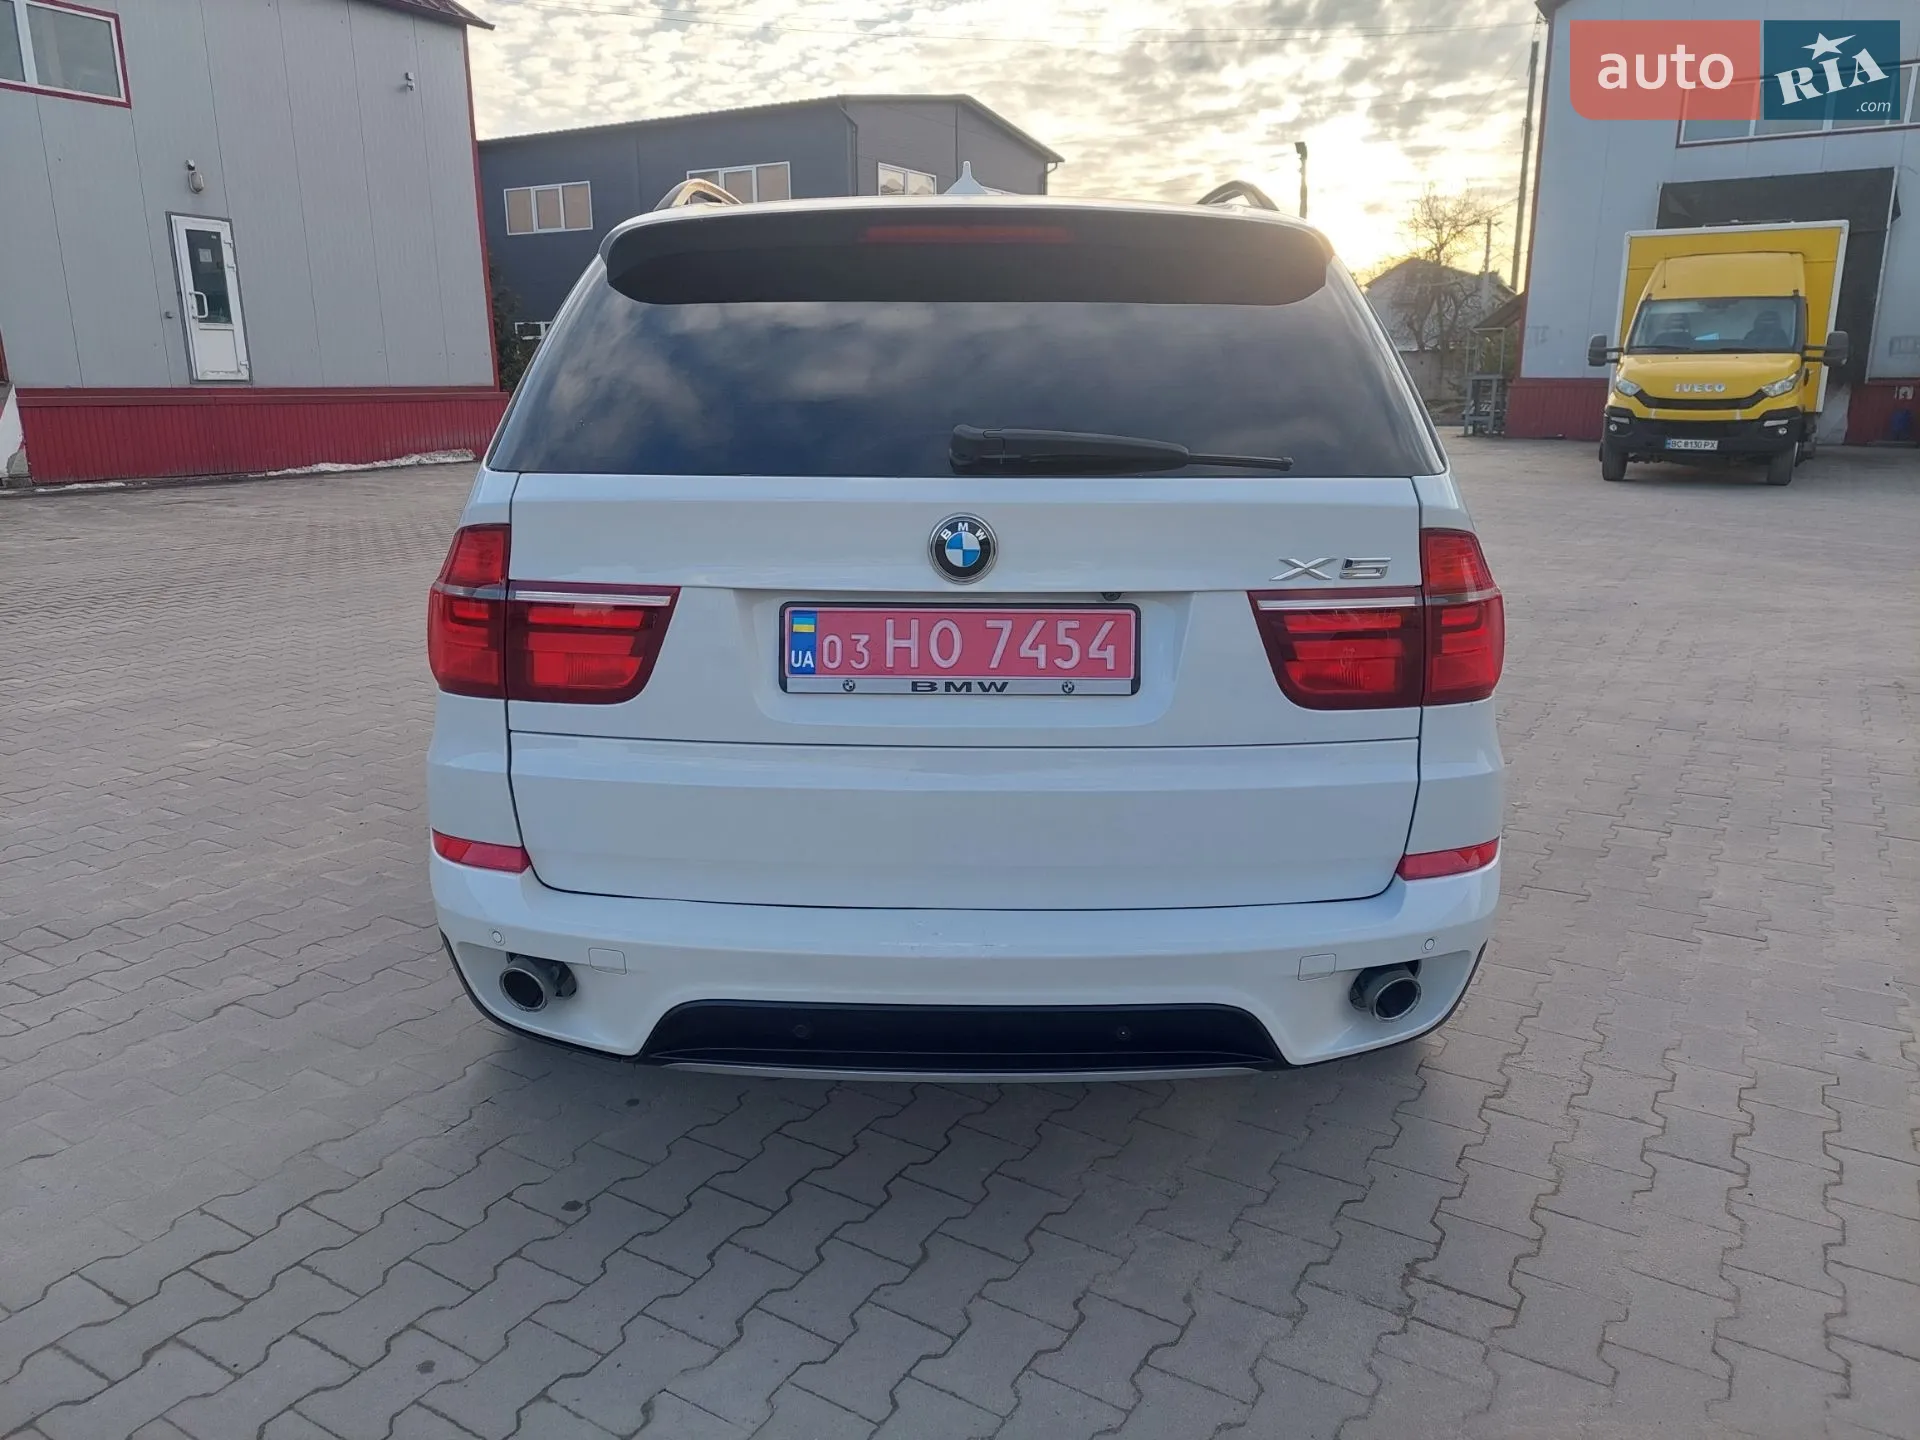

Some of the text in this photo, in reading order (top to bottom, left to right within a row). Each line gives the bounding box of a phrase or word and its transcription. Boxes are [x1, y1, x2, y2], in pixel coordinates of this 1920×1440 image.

[1675, 383, 1726, 393] IVECO
[940, 522, 987, 541] BMW
[1269, 557, 1392, 581] X5
[791, 618, 1116, 671] UA 03 HO 7454
[911, 681, 1009, 693] BMW
